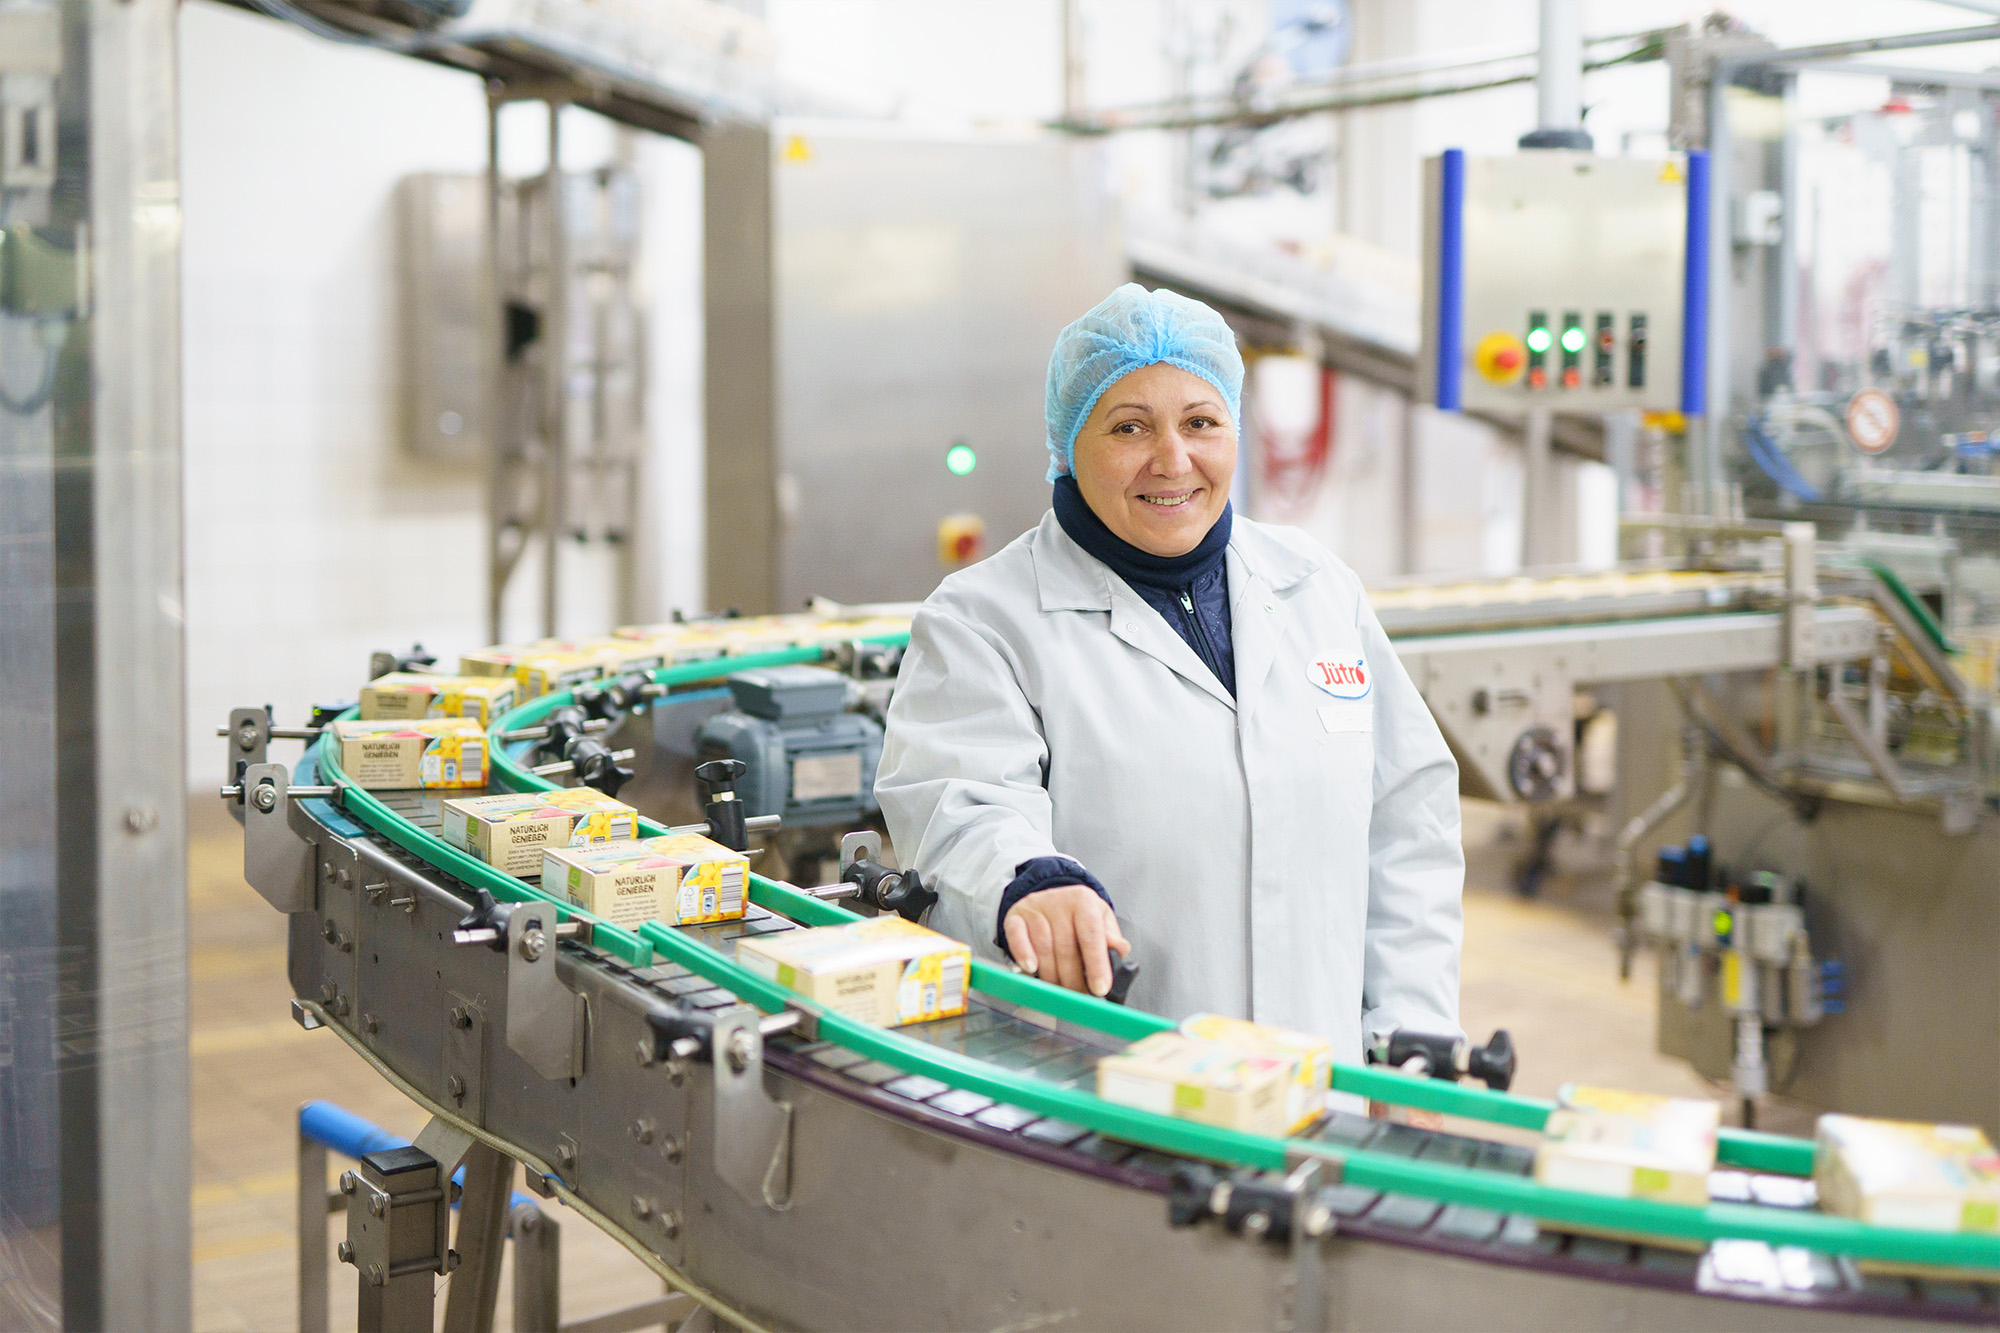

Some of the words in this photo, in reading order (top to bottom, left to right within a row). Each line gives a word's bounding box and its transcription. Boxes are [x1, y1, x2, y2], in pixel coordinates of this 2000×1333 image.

[1316, 660, 1366, 686] Jütro
[510, 823, 549, 835] NATÜRLICH
[615, 874, 656, 886] NATÜRLICH
